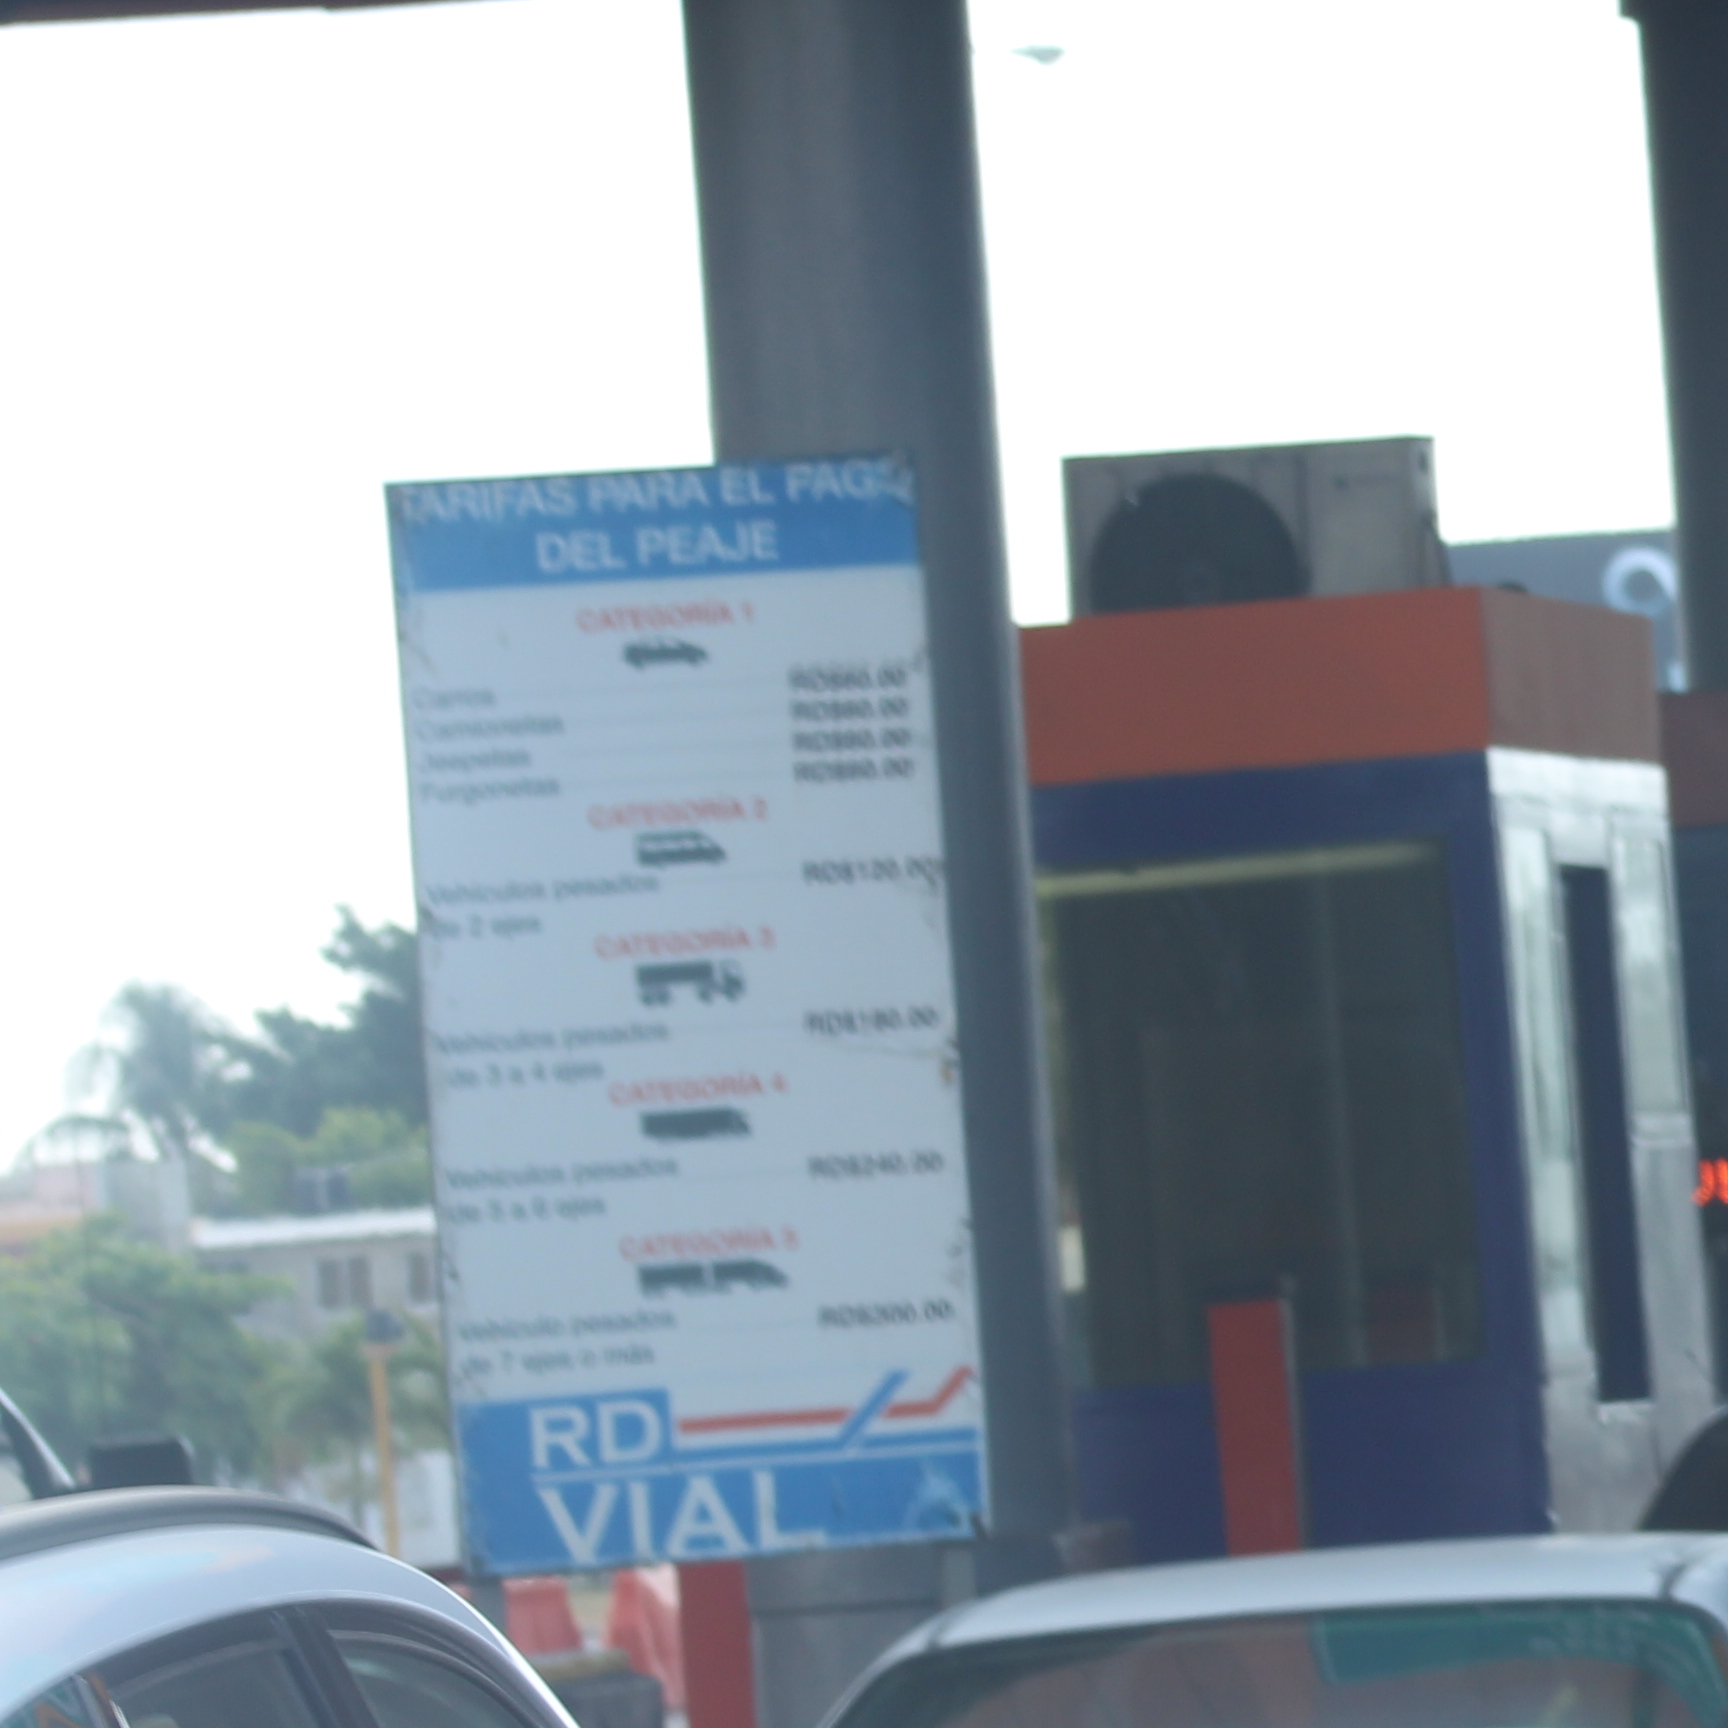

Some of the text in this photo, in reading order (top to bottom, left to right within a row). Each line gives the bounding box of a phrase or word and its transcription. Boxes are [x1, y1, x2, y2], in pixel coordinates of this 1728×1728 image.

[720, 465, 775, 507] EL
[536, 520, 779, 574] DEL PEAJE
[529, 1401, 665, 1471] RD
[537, 1468, 828, 1568] VIAL
